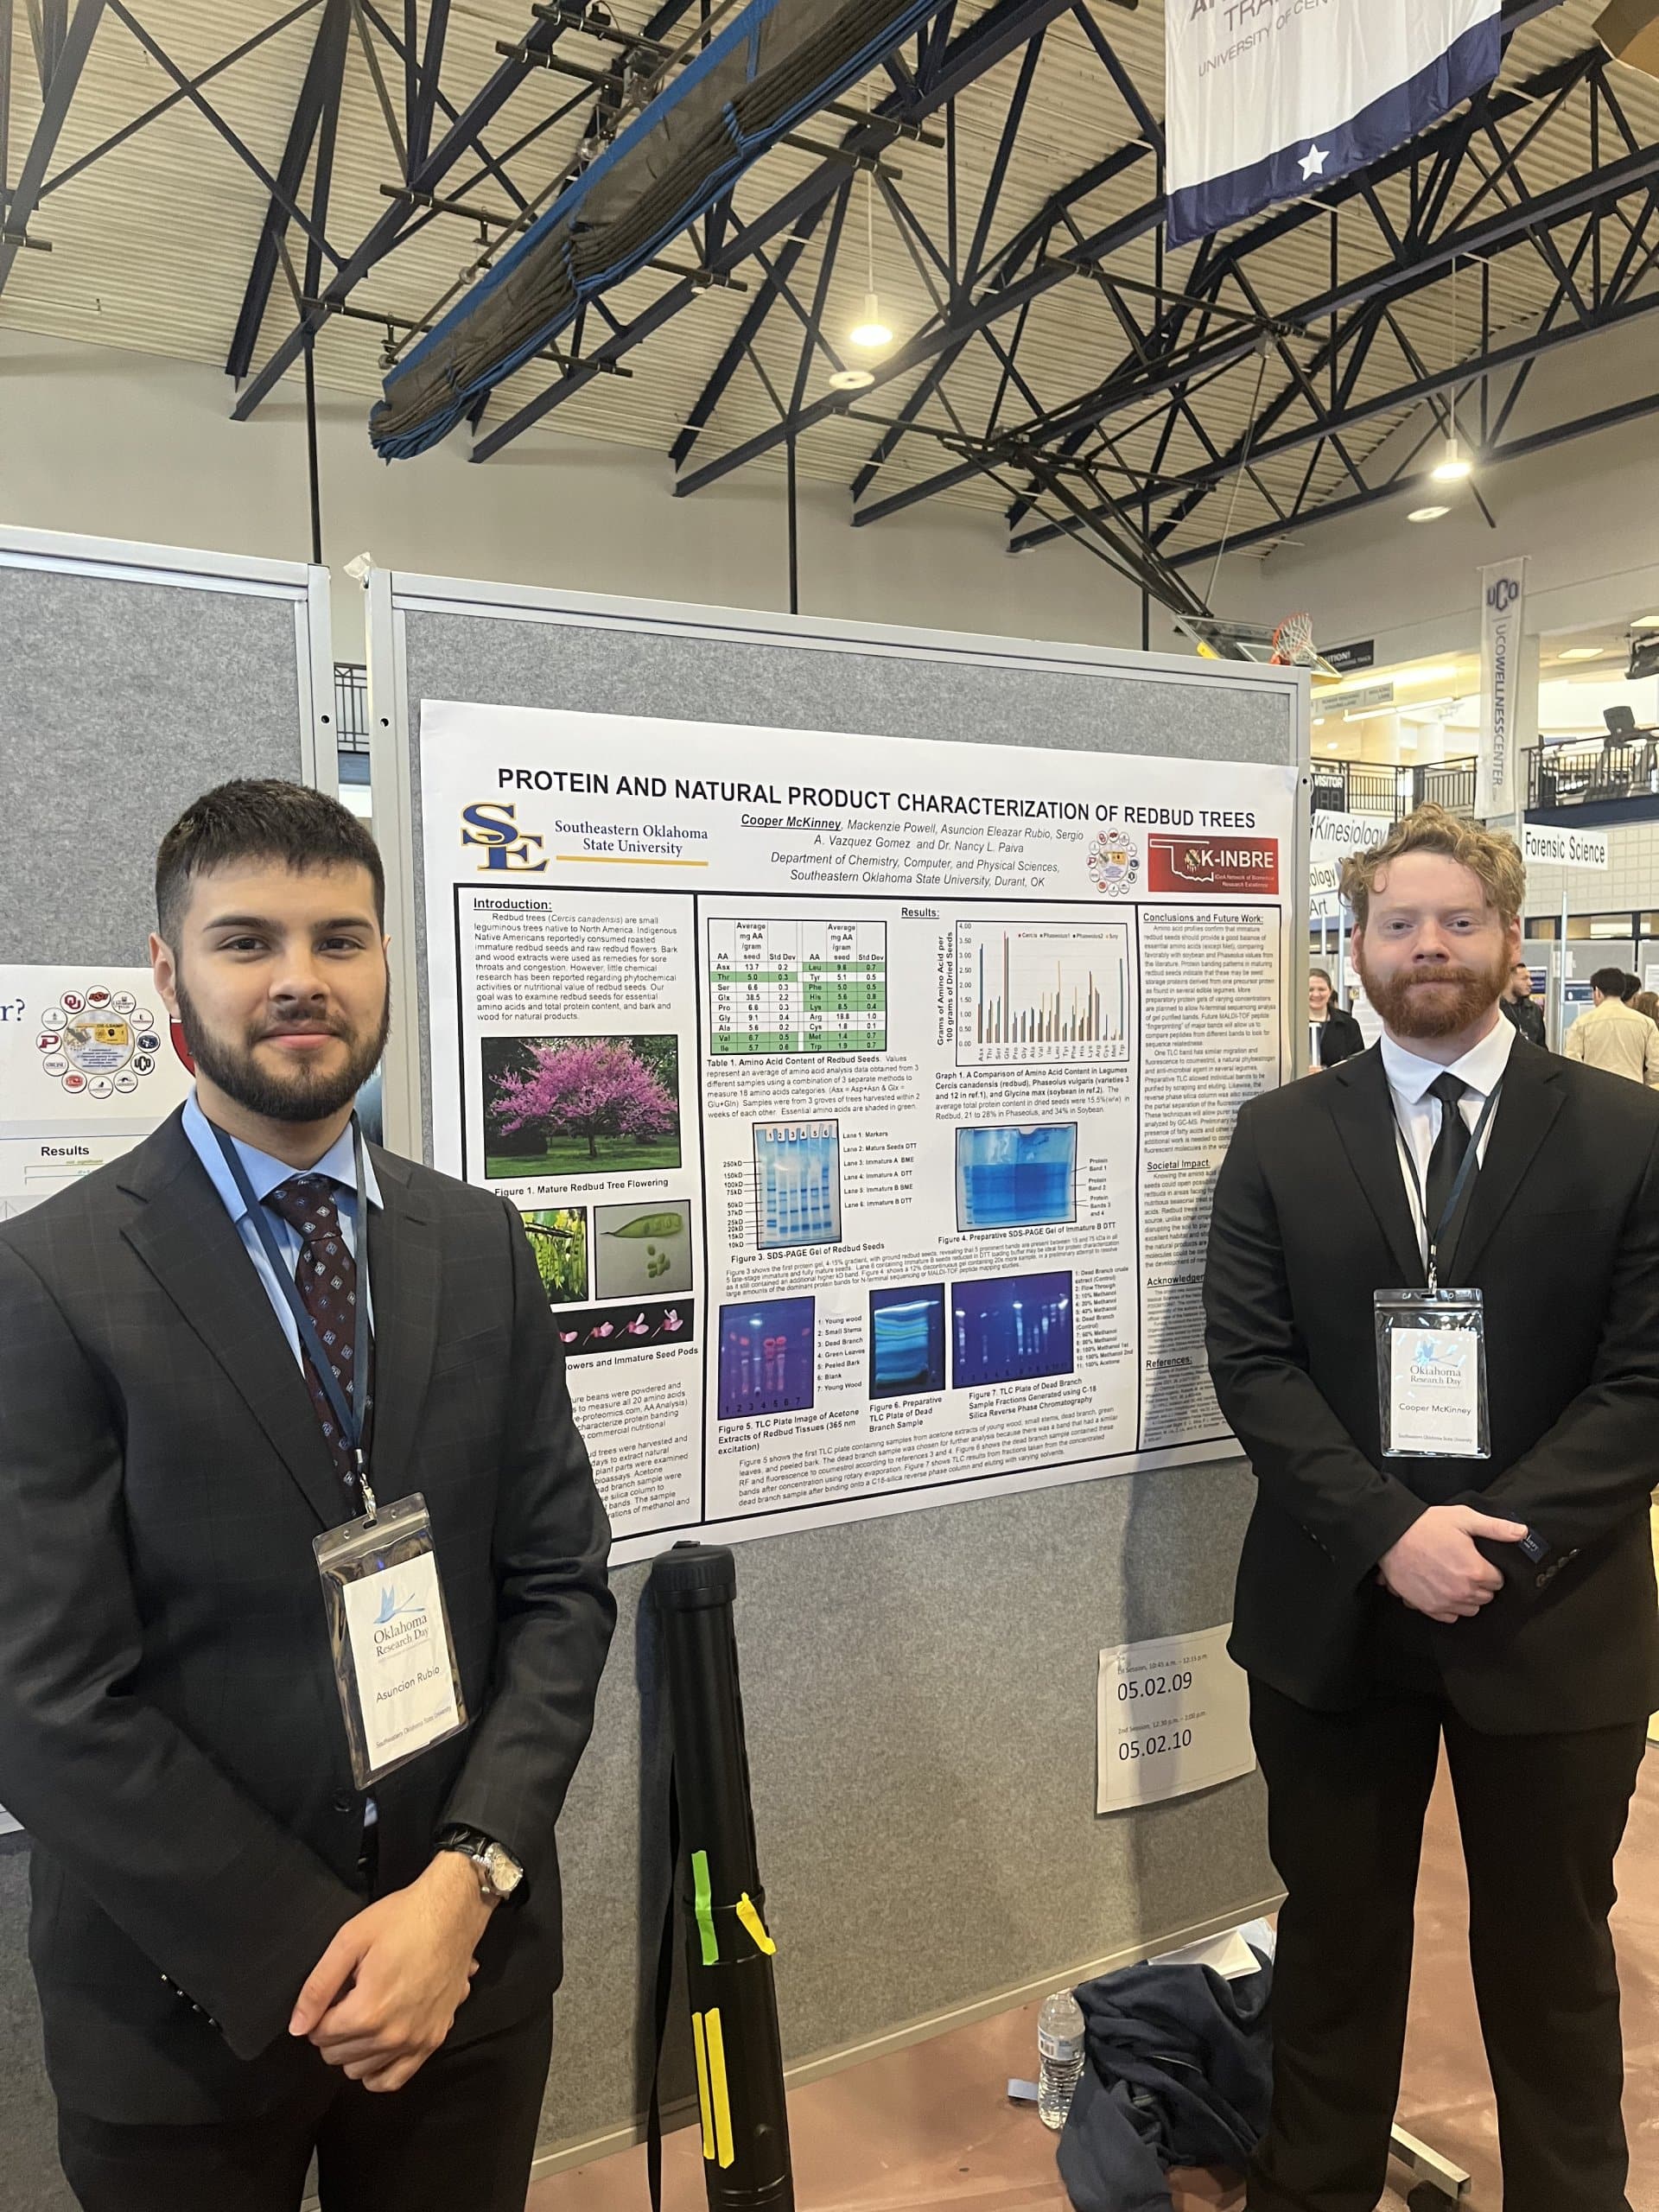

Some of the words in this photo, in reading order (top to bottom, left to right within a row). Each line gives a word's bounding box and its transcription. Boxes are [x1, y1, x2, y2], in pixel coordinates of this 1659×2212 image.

[1224, 0, 1279, 31] TRA
[1198, 22, 1272, 77] UNIVERSITY
[1276, 7, 1292, 29] OF
[1294, 0, 1328, 14] CE
[1487, 579, 1518, 612] UCO
[1314, 776, 1343, 787] VISITOR
[499, 768, 608, 794] PROTEIN
[616, 776, 666, 797] AND
[675, 779, 782, 804] NATURAL
[788, 786, 891, 810] PRODUCT
[897, 792, 1090, 821] CHARACTERIZATION
[1096, 804, 1119, 823] OF
[1124, 806, 1194, 826] REDBUD
[1199, 810, 1256, 829] TREES
[555, 821, 639, 836] Southeastern
[643, 824, 708, 839] Oklahoma
[741, 814, 784, 828] Cooper
[786, 817, 843, 830] McKinney,
[848, 820, 900, 831] Mackenzie
[904, 823, 938, 834] Powell,
[941, 824, 983, 836] Asuncion
[988, 826, 1021, 837] Eleazar
[1025, 829, 1053, 840] Rubio,
[1056, 830, 1084, 842] Sergio
[1315, 816, 1386, 845] Kinesiology
[583, 838, 613, 851] State
[618, 840, 683, 857] University
[814, 835, 824, 844] A.
[829, 836, 872, 848] Vazquez
[875, 837, 911, 848] Gomez
[938, 840, 950, 850] Dr.
[955, 842, 983, 852] Nancy
[987, 842, 995, 851] L.
[999, 842, 1024, 853] Paiva
[1526, 831, 1565, 859] Forensic
[1569, 836, 1605, 864] Science
[771, 852, 832, 865] Department
[836, 854, 846, 864] of
[849, 855, 899, 868] Chemistry,
[904, 857, 952, 869] Computer,
[956, 860, 974, 869] and
[976, 859, 1015, 873] Physical
[1018, 859, 1059, 873] Sciences,
[791, 869, 858, 881] Southeastern
[862, 872, 912, 883] Oklahoma
[916, 874, 941, 884] State
[944, 874, 992, 887] University,
[995, 876, 1027, 887] Durant,
[1031, 878, 1045, 887] OK
[1310, 867, 1335, 887] ology
[474, 898, 552, 911] Introduction:
[901, 907, 940, 918] Results:
[548, 914, 575, 923] (Cercis
[577, 916, 623, 925] canadensis)
[1144, 913, 1194, 922] Conclusions
[1213, 914, 1239, 923] Future
[1241, 914, 1263, 923] Work:
[474, 924, 521, 932] leguminous
[938, 1006, 944, 1014] of
[41, 1146, 90, 1156] Results
[1147, 1161, 1179, 1171] Societal
[495, 1187, 524, 1197] Figure
[527, 1186, 535, 1195] 1.
[537, 1185, 568, 1194] Mature
[571, 1182, 604, 1192] Redbud
[607, 1180, 625, 1189] Tree
[628, 1179, 669, 1188] Flowering
[969, 1232, 1007, 1242] Preparative
[1008, 1229, 1043, 1238] SDS-PAGE
[1066, 1224, 1096, 1232] Immature
[731, 1255, 756, 1264] Figure
[767, 1250, 807, 1260] SDS-PAGE
[862, 1243, 885, 1251] Seeds
[567, 1361, 594, 1370] owers
[596, 1358, 612, 1367] and
[614, 1354, 653, 1365] Immature
[656, 1350, 675, 1359] Seed
[678, 1347, 698, 1356] Pods
[1147, 1356, 1192, 1369] References:
[1410, 1365, 1461, 1376] Oklahoma
[1446, 1376, 1461, 1385] Day
[1399, 1403, 1429, 1413] Cooper
[1432, 1405, 1471, 1415] McKinney
[719, 1424, 744, 1433] Figure
[755, 1421, 771, 1429] TLC
[773, 1417, 792, 1426] Plate
[794, 1414, 817, 1423] Image
[830, 1409, 859, 1418] Acetone
[373, 1615, 428, 1644] Oklahoma
[377, 1634, 412, 1656] Research
[414, 1627, 429, 1641] Day
[376, 1679, 415, 1703] Asuncion
[417, 1666, 440, 1683] Rubio
[1118, 1672, 1192, 1700] 05.02.09
[1119, 1729, 1192, 1760] 05.02.10
